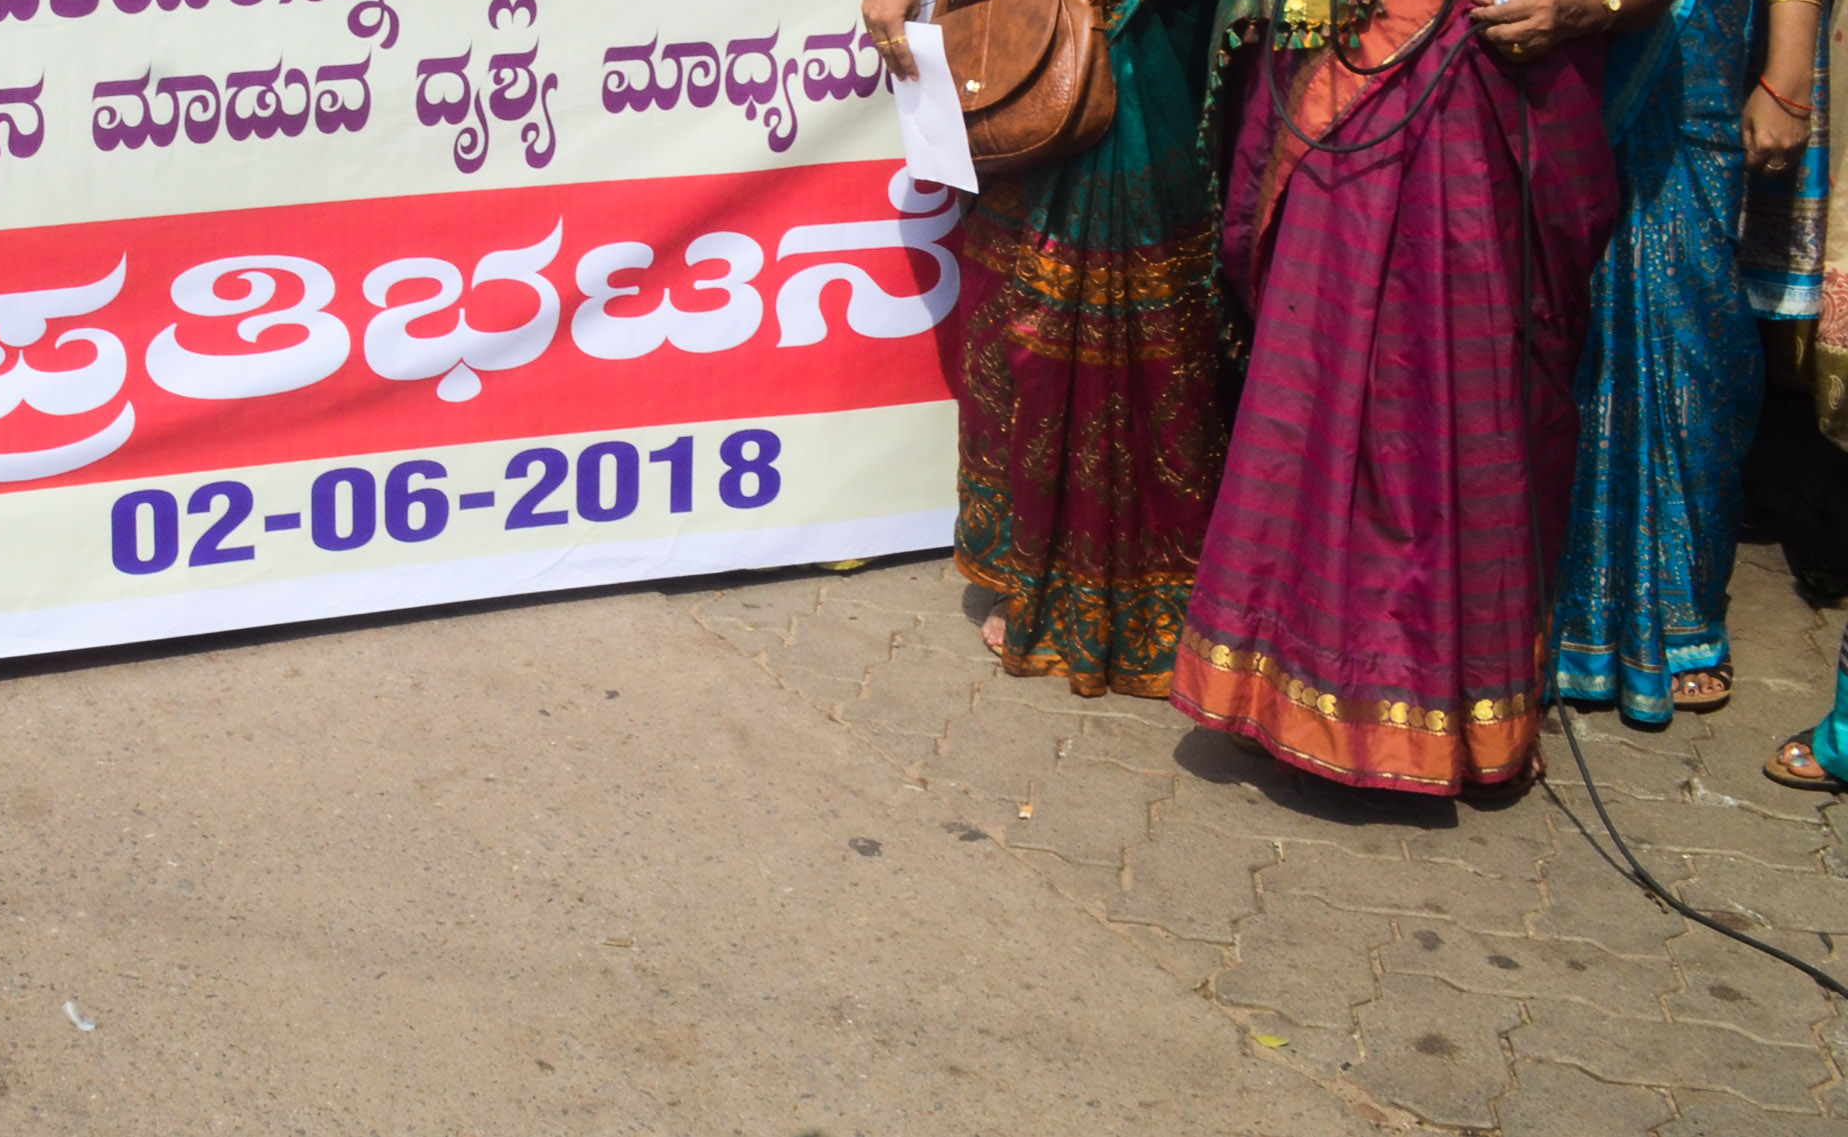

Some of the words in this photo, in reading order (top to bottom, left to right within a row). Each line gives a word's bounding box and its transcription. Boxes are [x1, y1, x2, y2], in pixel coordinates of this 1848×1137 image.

[91, 47, 371, 152] ಮಾಡುವ
[415, 38, 558, 174] ದೃಶ್ಯ
[110, 430, 783, 576] 02-06-2018
